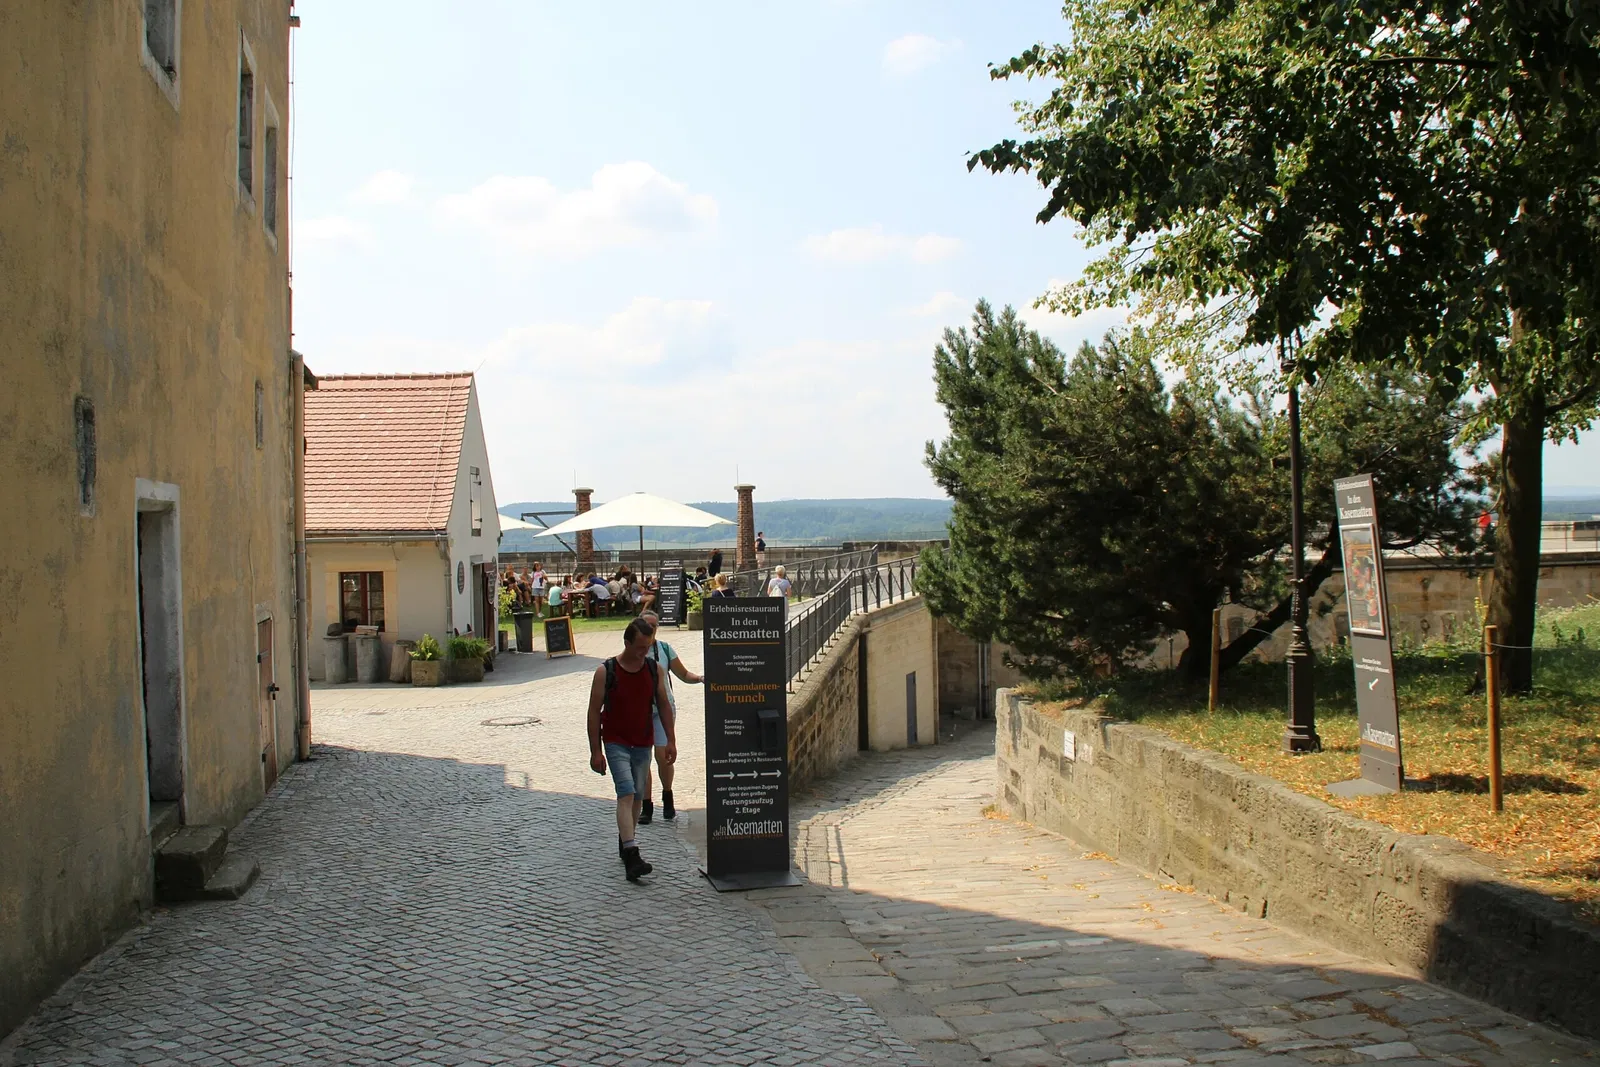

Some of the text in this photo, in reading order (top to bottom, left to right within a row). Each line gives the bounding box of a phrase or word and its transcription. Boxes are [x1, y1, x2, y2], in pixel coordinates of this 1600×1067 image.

[709, 604, 780, 613] Erlebnisrestaurant
[731, 618, 758, 626] In den
[710, 628, 780, 639] Kasematten
[710, 682, 780, 692] Kommandanten-
[726, 693, 765, 704] brunch
[722, 798, 774, 806] Festungsaufzug
[726, 818, 783, 836] Kasematten
